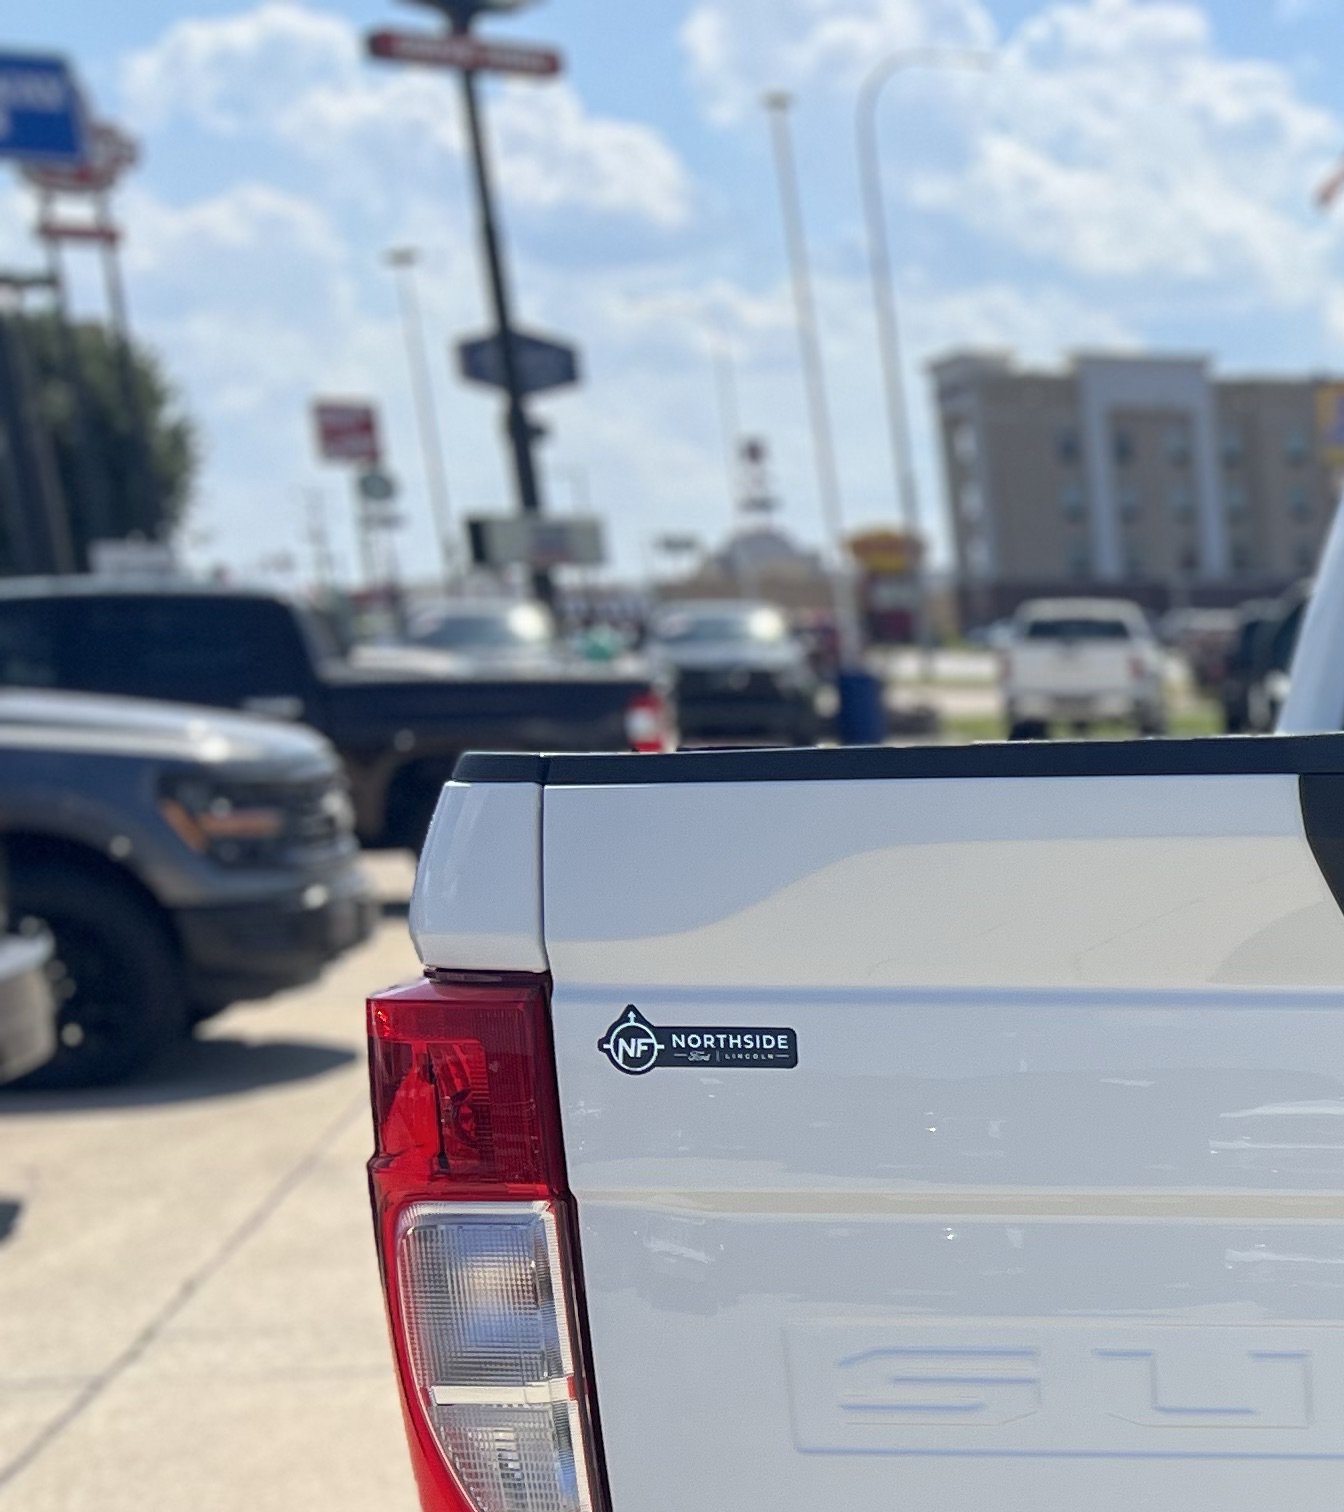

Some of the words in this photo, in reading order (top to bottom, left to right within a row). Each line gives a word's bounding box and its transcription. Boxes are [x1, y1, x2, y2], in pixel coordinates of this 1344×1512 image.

[671, 1034, 789, 1049] NORTHSIDE
[618, 1038, 654, 1063] NF
[688, 1051, 711, 1062] Ford
